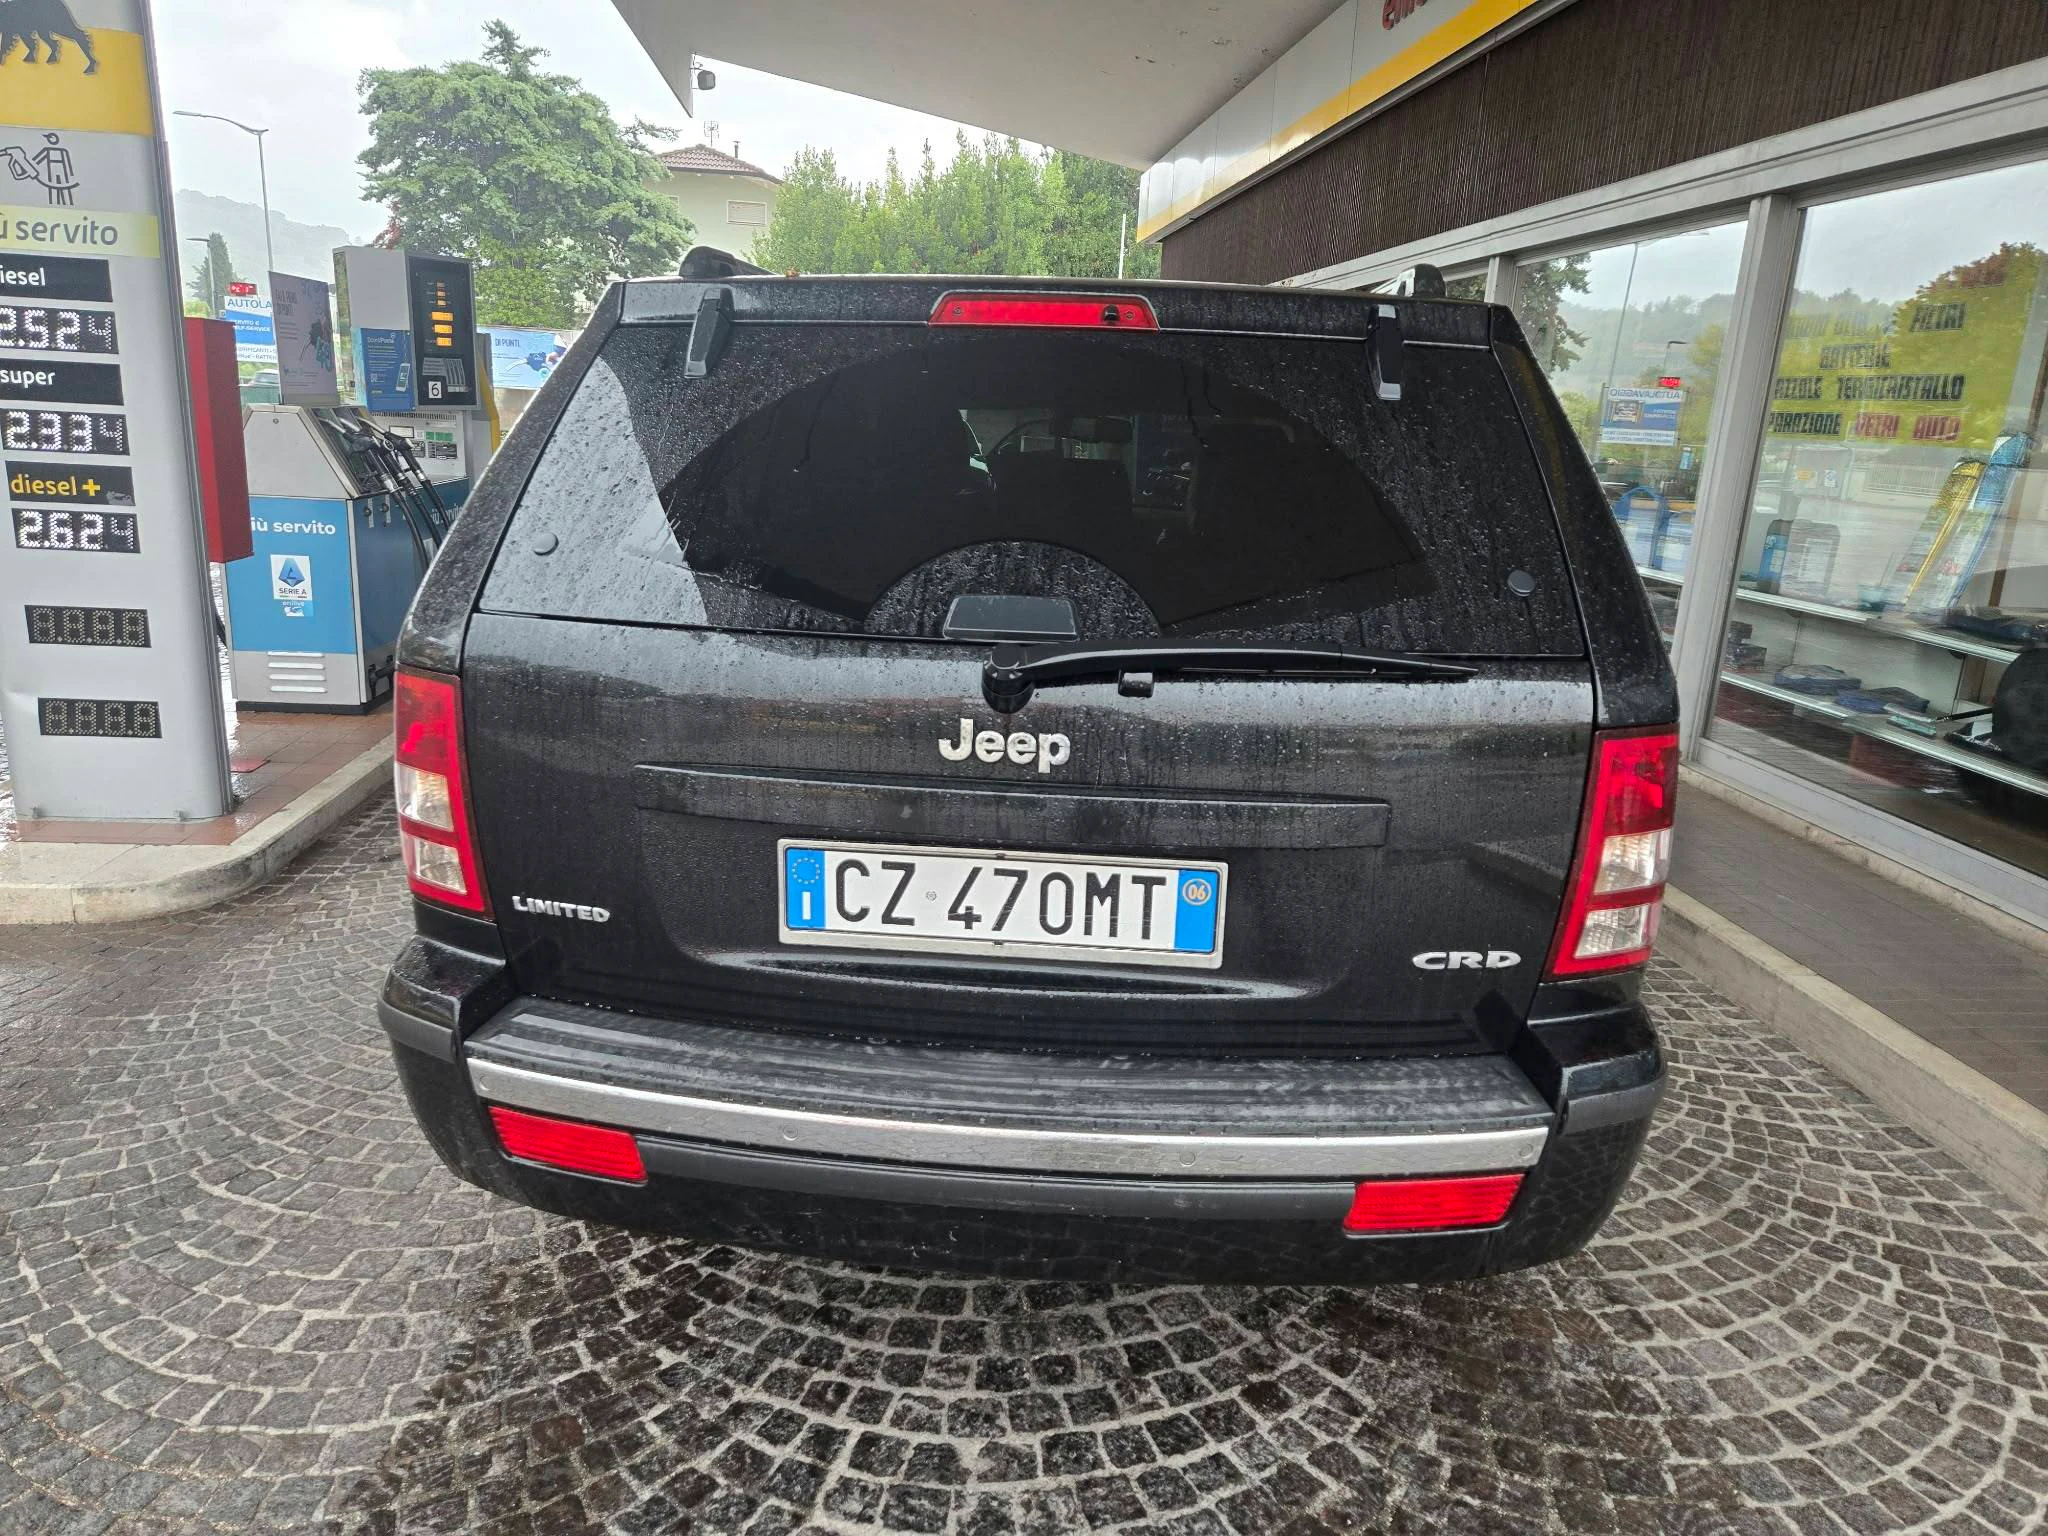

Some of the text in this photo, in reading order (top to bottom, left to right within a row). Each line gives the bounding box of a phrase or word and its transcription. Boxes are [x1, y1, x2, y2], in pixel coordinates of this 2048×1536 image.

[16, 215, 119, 246] servito
[0, 264, 46, 286] iesel
[228, 299, 272, 308] AUTOLA
[0, 369, 55, 389] super
[11, 473, 78, 496] diesel
[250, 516, 336, 535] iù servito
[279, 587, 300, 595] SERIE
[938, 718, 1072, 774] Jeep
[511, 895, 611, 923] LIMITED
[835, 859, 1167, 941] CZ 470MT
[1411, 950, 1522, 970] CRD
